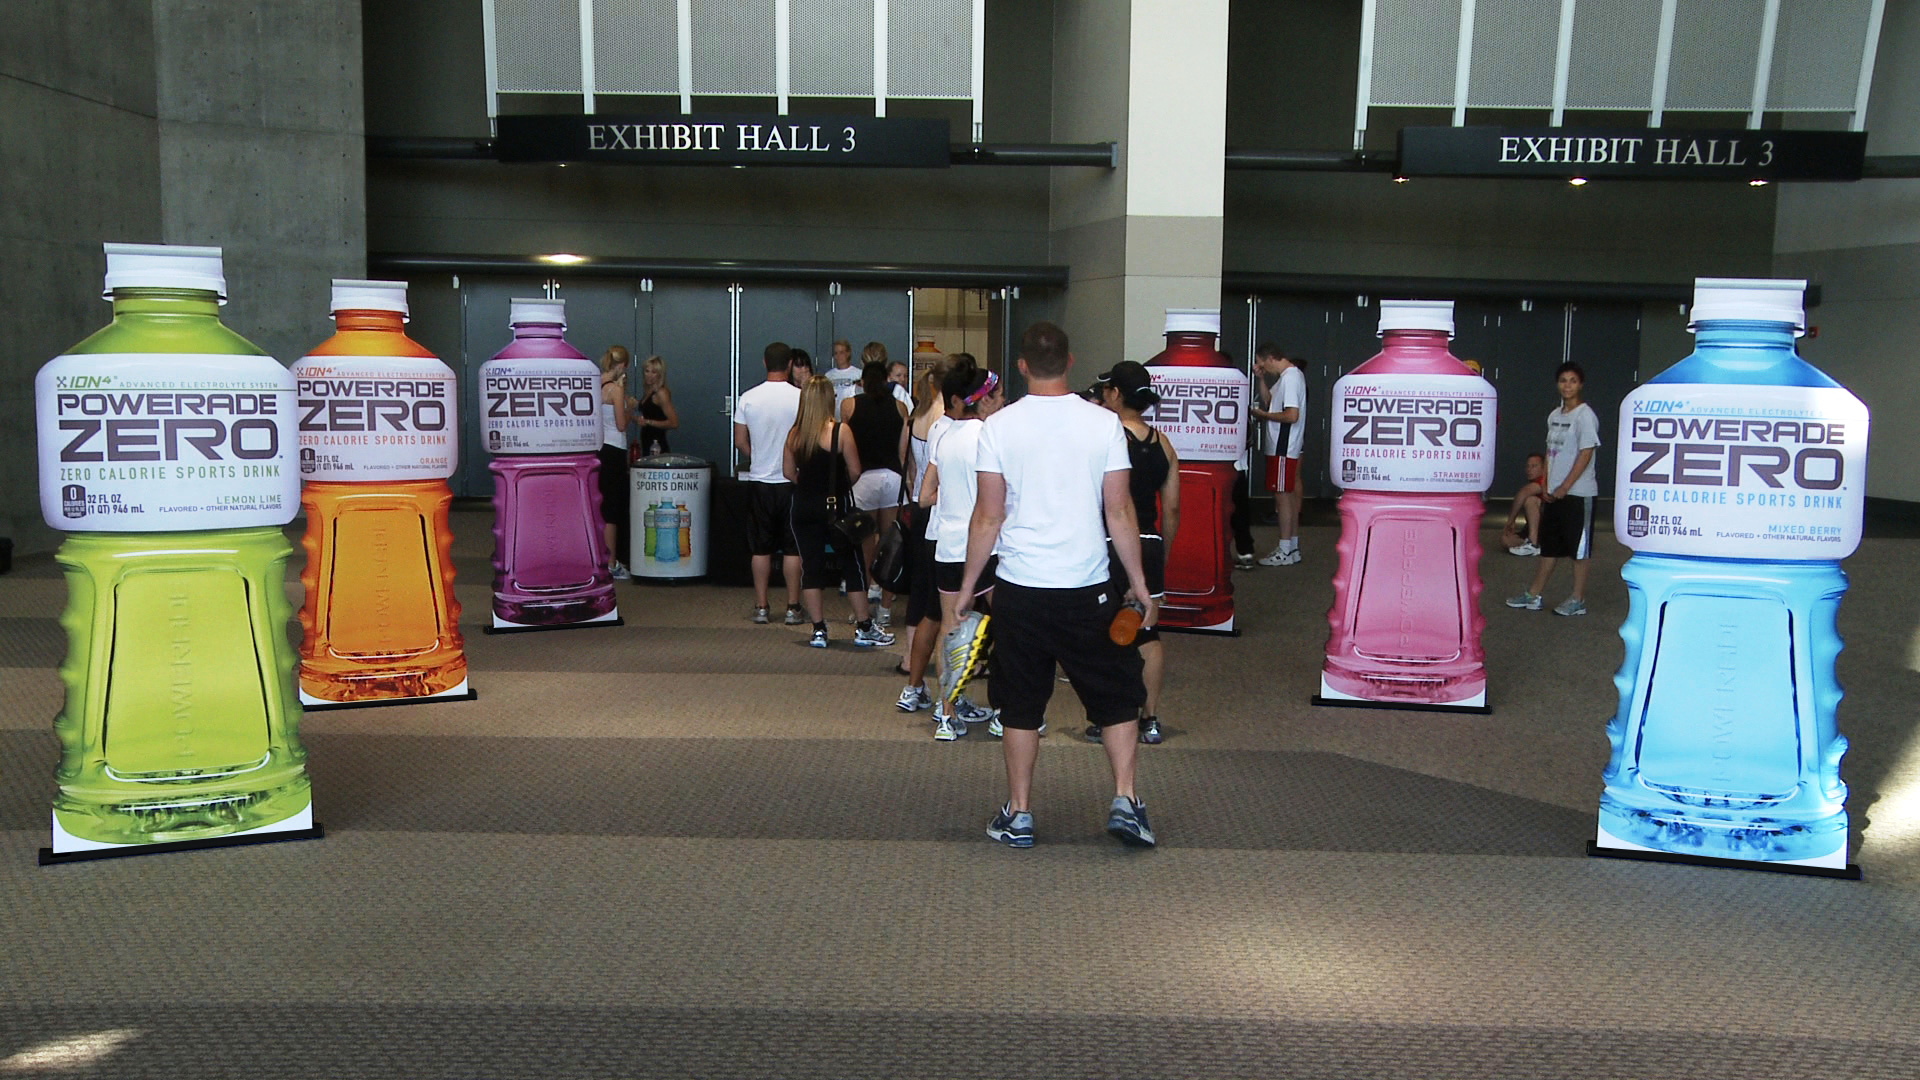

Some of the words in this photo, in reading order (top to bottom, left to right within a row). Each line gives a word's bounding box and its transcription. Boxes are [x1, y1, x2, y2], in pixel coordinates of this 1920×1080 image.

[587, 124, 725, 151] EXHIBIT
[736, 125, 829, 152] HALL
[842, 127, 857, 152] 3
[1499, 136, 1643, 164] EXHIBIT
[1653, 139, 1747, 166] HALL
[1758, 141, 1774, 166] 3
[297, 380, 444, 397] POWERADE
[486, 377, 592, 390] POWERADE
[57, 393, 277, 415] POWERADE
[487, 392, 594, 417] ZERO
[1344, 398, 1482, 415] POWERADE
[298, 400, 446, 431] ZERO
[1749, 408, 1814, 416] ELECTROLYTE
[488, 420, 503, 429] ZERO
[506, 420, 540, 428] CALORIE
[544, 420, 574, 428] SPORTS
[576, 419, 595, 427] DRINK
[1185, 426, 1215, 434] SPORTS
[1219, 427, 1238, 435] DRINK
[1632, 417, 1845, 444] POWERADE
[1343, 416, 1482, 447] ZERO
[58, 418, 279, 462] ZERO
[299, 435, 319, 445] ZERO
[324, 435, 368, 445] CALORIE
[375, 435, 416, 445] SPORTS
[421, 435, 447, 445] DRINK
[1342, 448, 1360, 457] ZERO
[1365, 448, 1406, 459] CALORIE
[1412, 449, 1451, 460] SPORTS
[1456, 450, 1481, 460] DRINK
[1630, 442, 1844, 490] ZERO
[60, 468, 91, 481] ZERO
[99, 467, 166, 480] CALORIE
[176, 466, 236, 479] SPORTS
[243, 465, 280, 478] DRINK
[648, 471, 670, 480] ZERO
[672, 472, 699, 480] CALORIE
[636, 481, 668, 491] SPORTS
[671, 481, 699, 491] DRINK
[70, 486, 77, 500] 0
[87, 494, 96, 504] 32
[99, 494, 108, 503] FL
[111, 494, 122, 503] OZ
[216, 496, 256, 504] LEMON
[260, 495, 282, 503] LIME
[1628, 488, 1656, 501] ZERO
[1664, 490, 1726, 504] CALORIE
[1736, 493, 1796, 507] SPORTS
[1804, 495, 1842, 509] DRINK
[87, 505, 94, 515] (1
[98, 505, 110, 515] QT)
[113, 504, 128, 514] 946
[131, 504, 144, 513] mL
[1635, 507, 1642, 519] 0
[1650, 515, 1659, 524] 32
[1661, 516, 1669, 525] FL
[1672, 516, 1682, 525] OZ
[1650, 525, 1656, 535] (1
[1659, 526, 1670, 536] QT)
[1672, 526, 1687, 536] 946
[1689, 527, 1702, 536] mL
[1768, 525, 1805, 534] MIXED
[1810, 526, 1842, 535] BERRY
